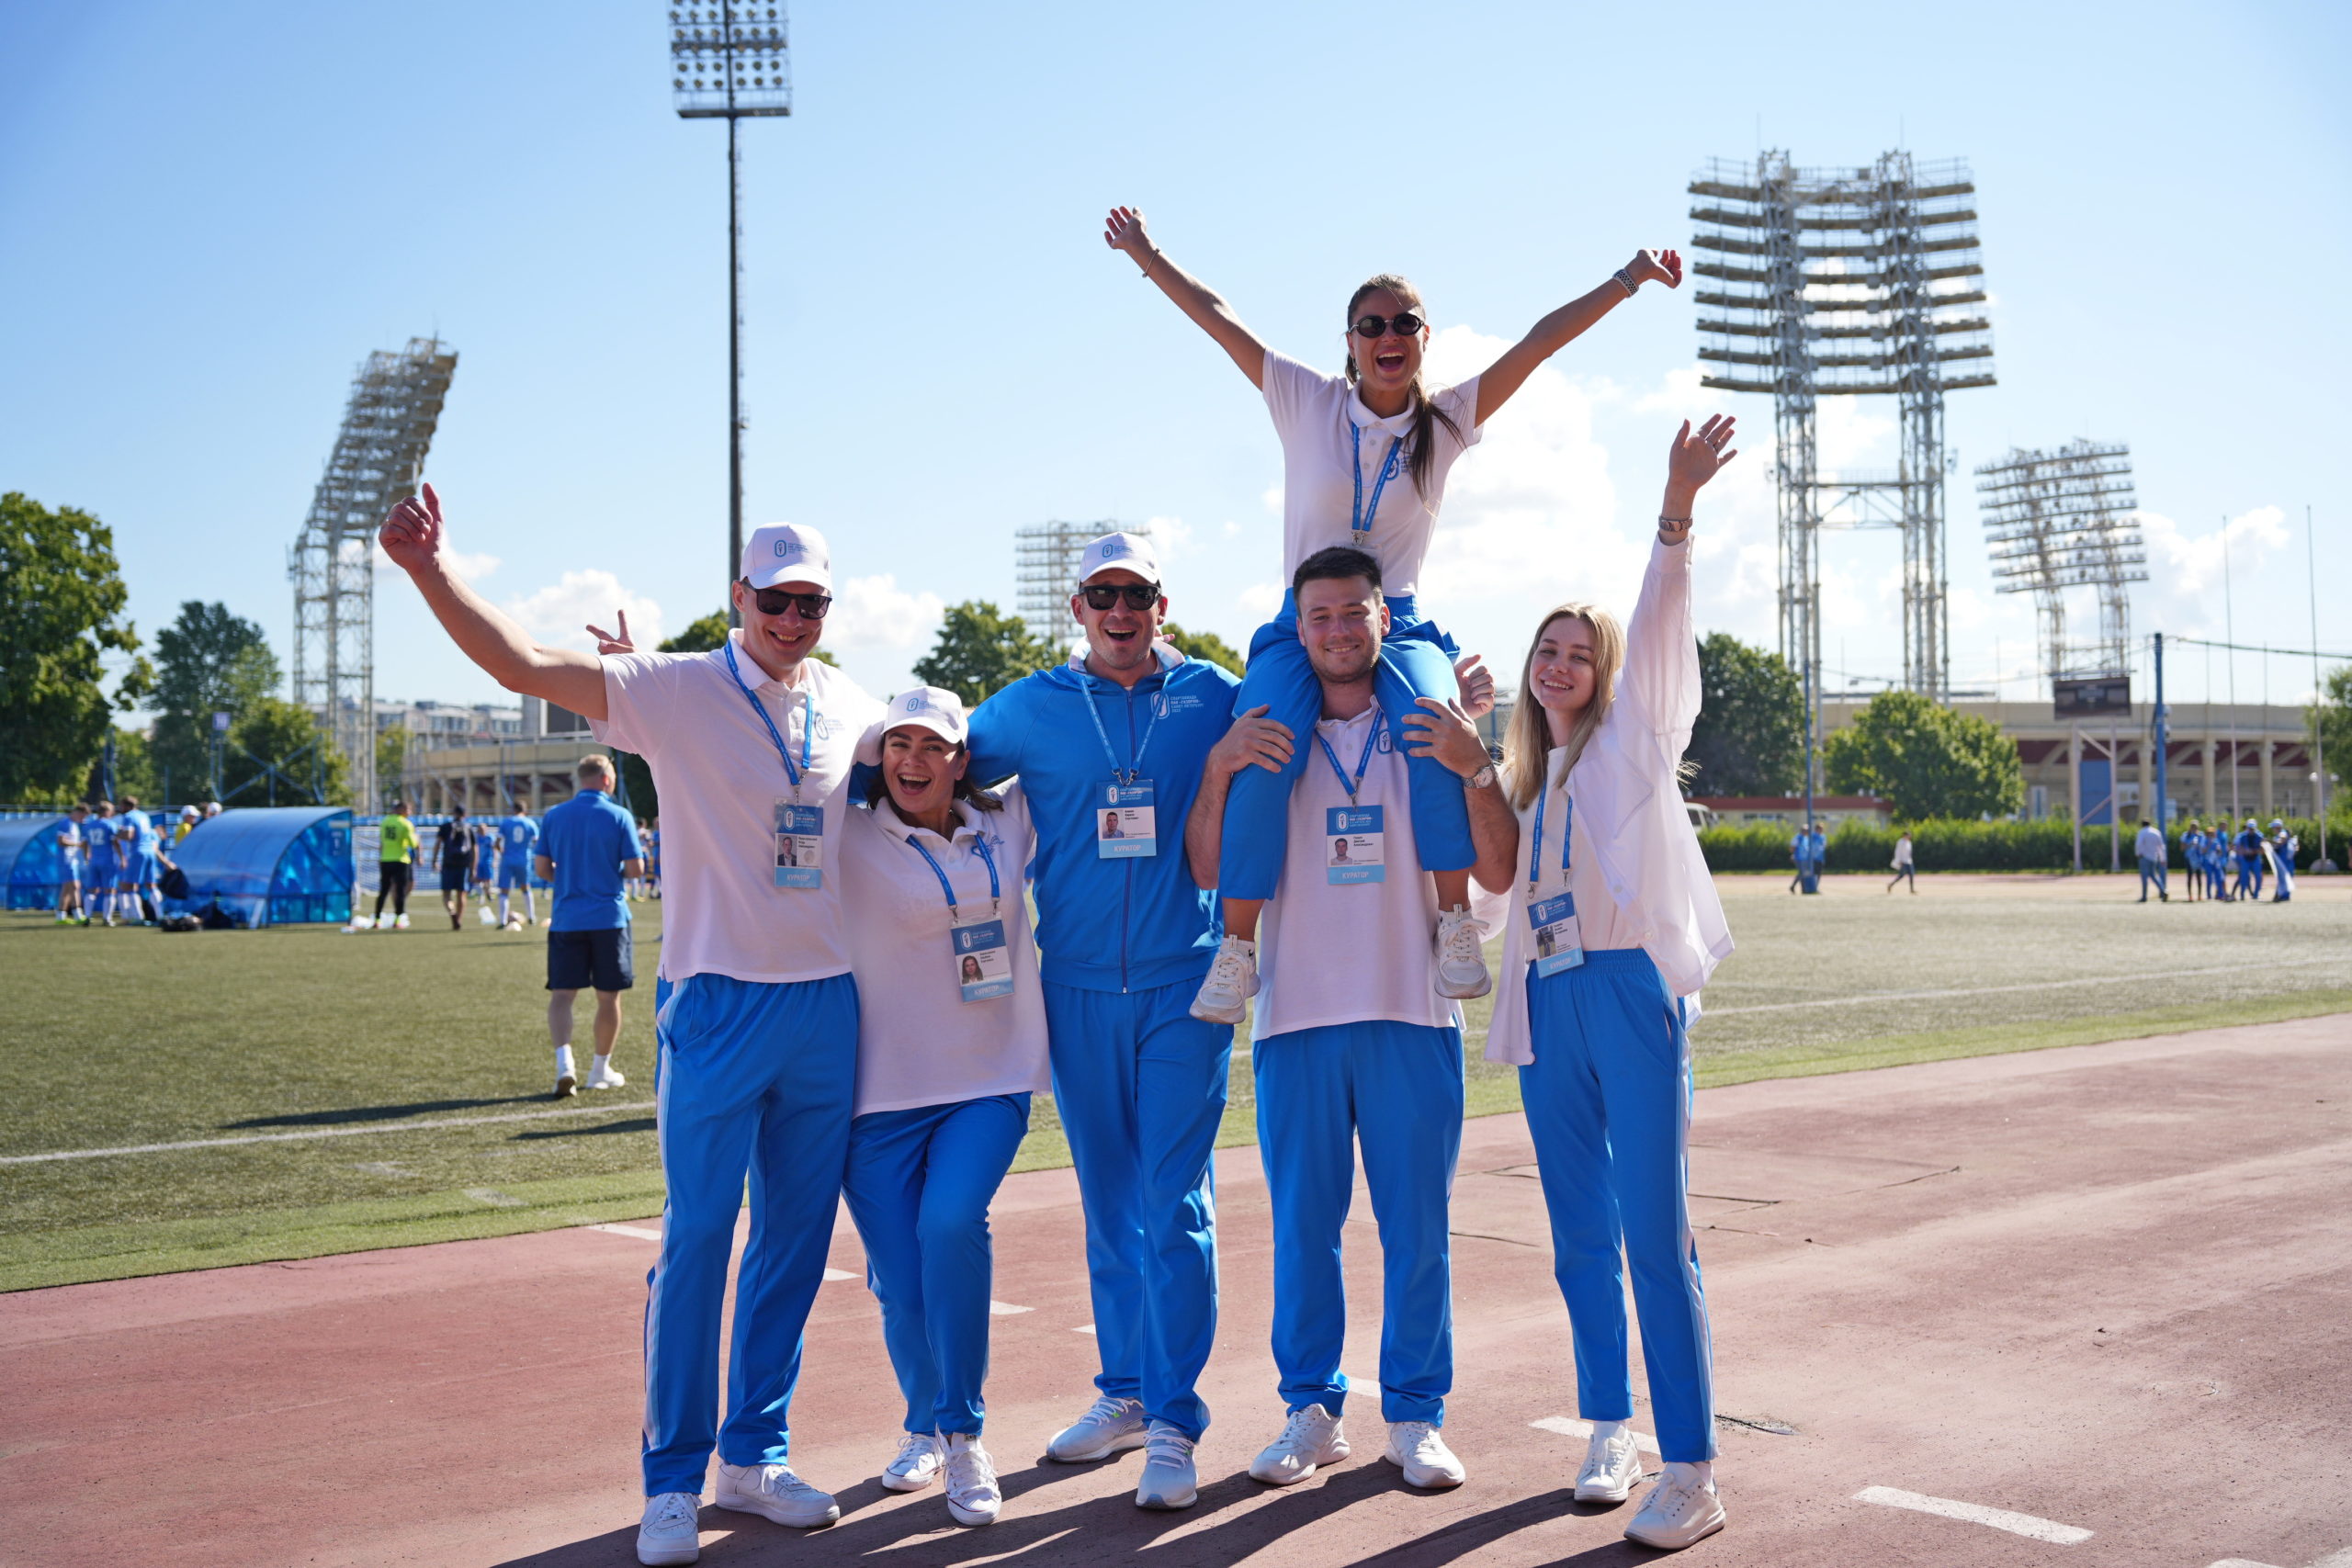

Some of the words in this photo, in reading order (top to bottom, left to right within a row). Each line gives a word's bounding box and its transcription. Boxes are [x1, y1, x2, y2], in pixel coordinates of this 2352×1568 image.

[88, 829, 105, 845] 12
[513, 826, 525, 843] 9
[787, 874, 810, 882] КУРАТОР
[1342, 871, 1369, 879] КУРАТОР
